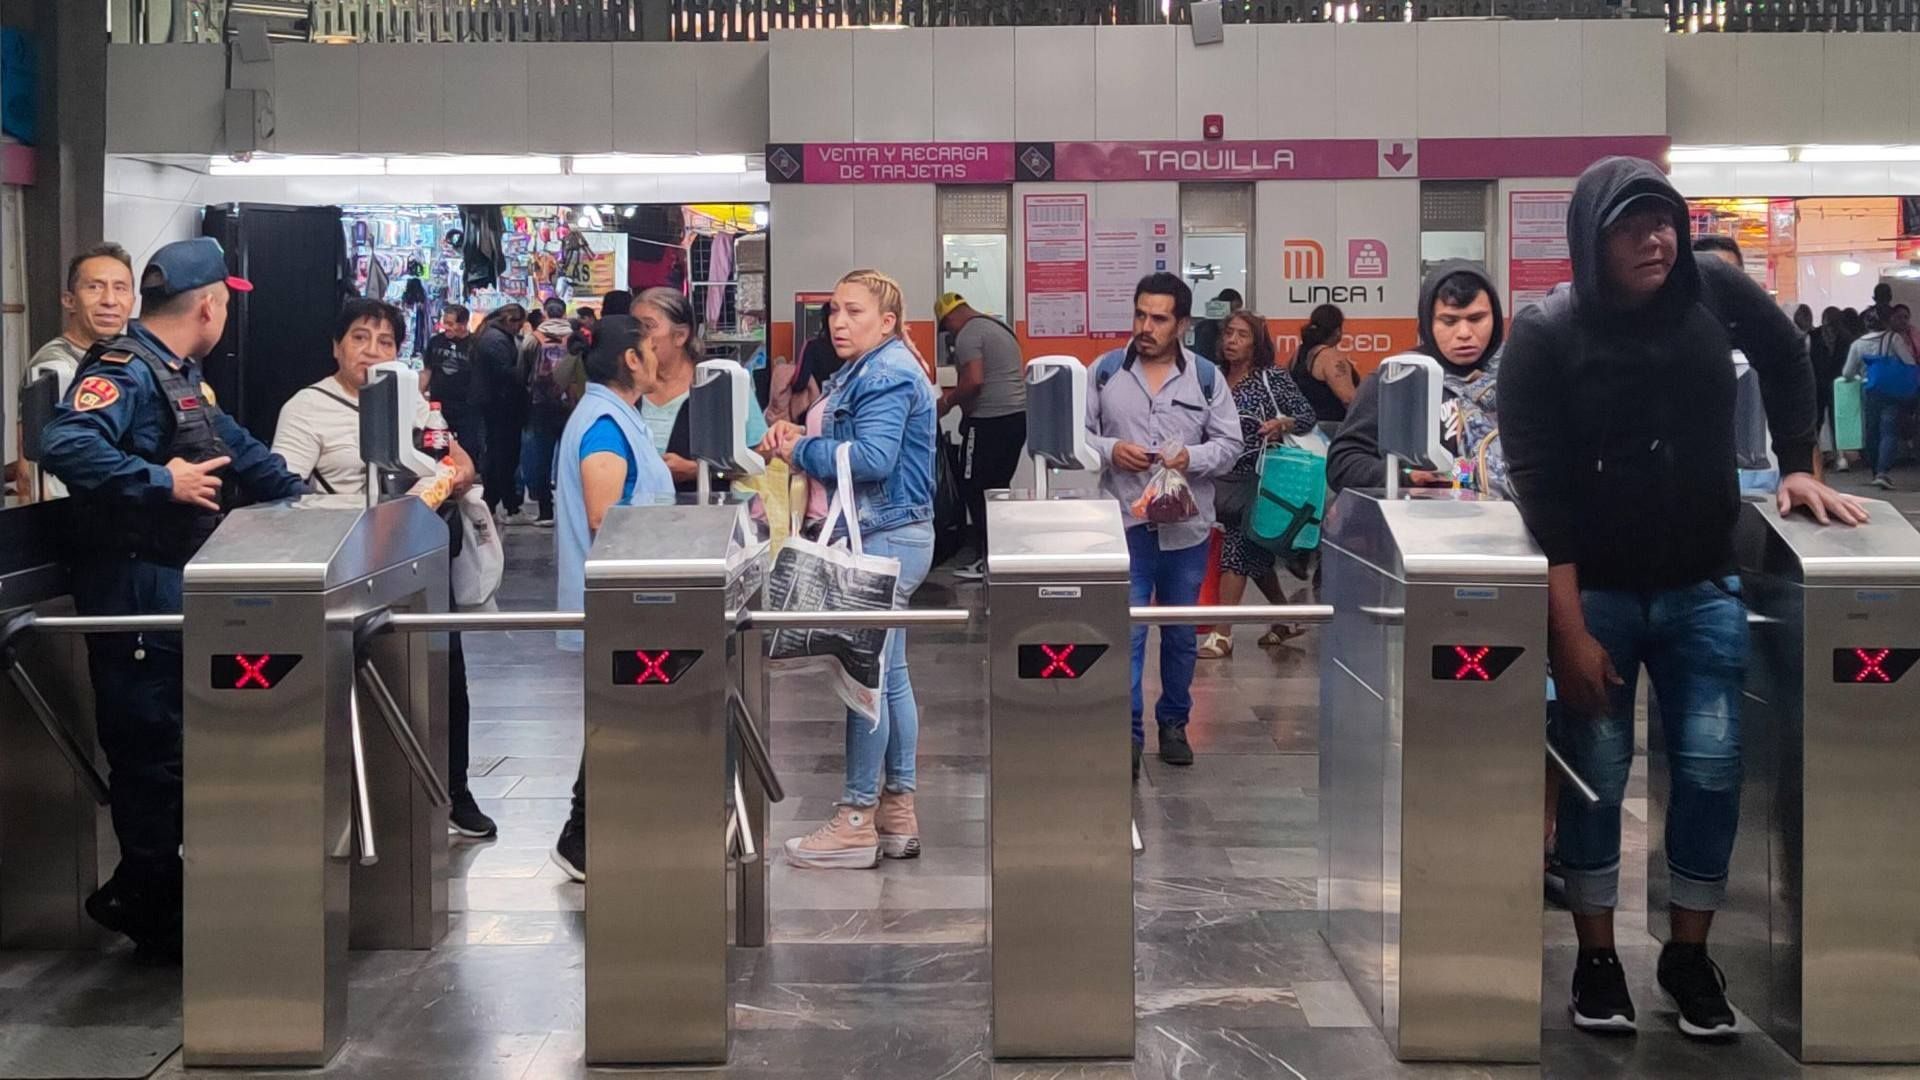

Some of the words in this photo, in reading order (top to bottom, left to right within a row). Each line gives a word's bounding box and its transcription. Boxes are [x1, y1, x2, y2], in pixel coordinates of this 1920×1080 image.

[819, 147, 879, 161] VENTA
[884, 147, 897, 161] Y
[901, 146, 989, 161] RECARGA
[1138, 149, 1295, 171] TAQUILLA
[840, 165, 865, 179] DE
[870, 164, 967, 179] TARJETAS
[1289, 285, 1367, 303] LINEA
[1376, 285, 1384, 303] 1
[1276, 334, 1391, 352] MCED
